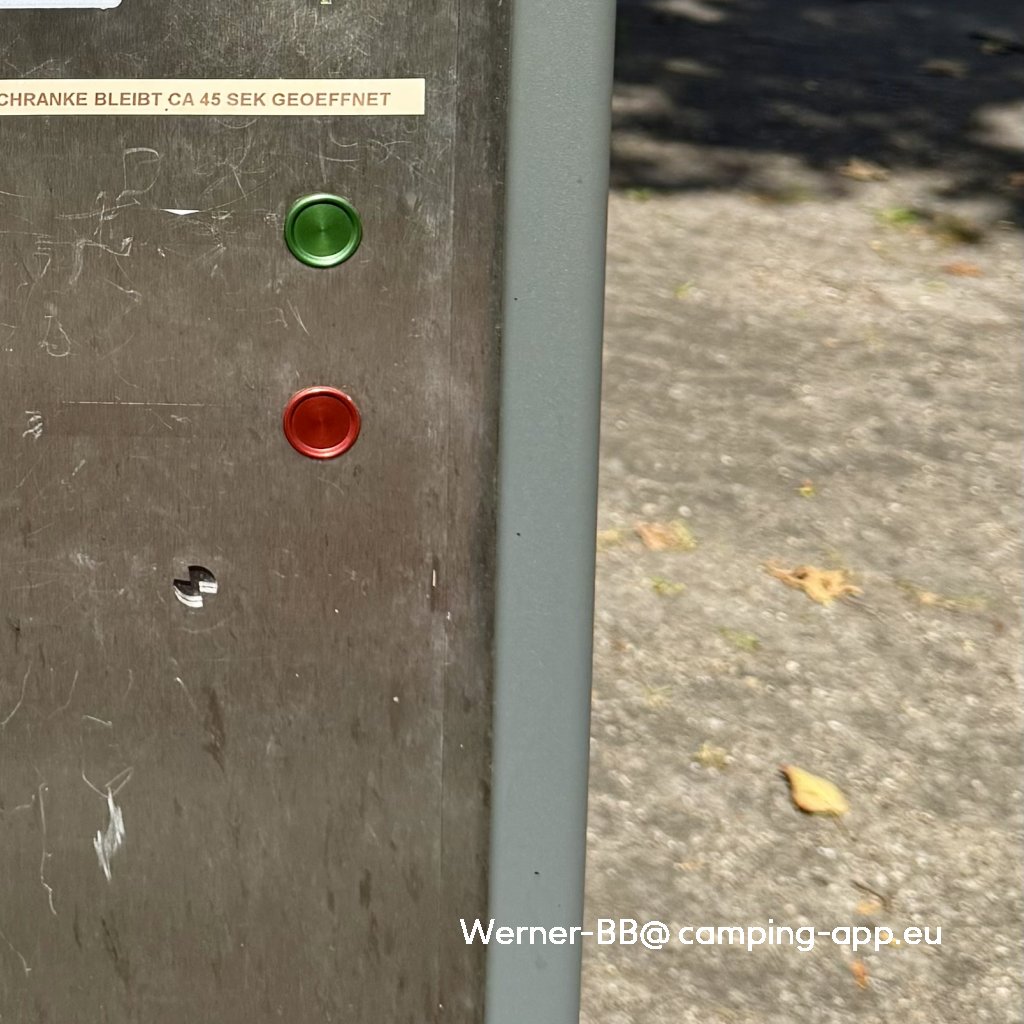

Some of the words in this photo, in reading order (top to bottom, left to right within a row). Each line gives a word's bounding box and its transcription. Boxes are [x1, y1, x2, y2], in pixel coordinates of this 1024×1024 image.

[94, 92, 162, 107] BLEIBT
[168, 92, 194, 106] CA
[200, 92, 221, 106] 45
[227, 92, 266, 106] SEK
[272, 92, 391, 107] GEOEFFNET
